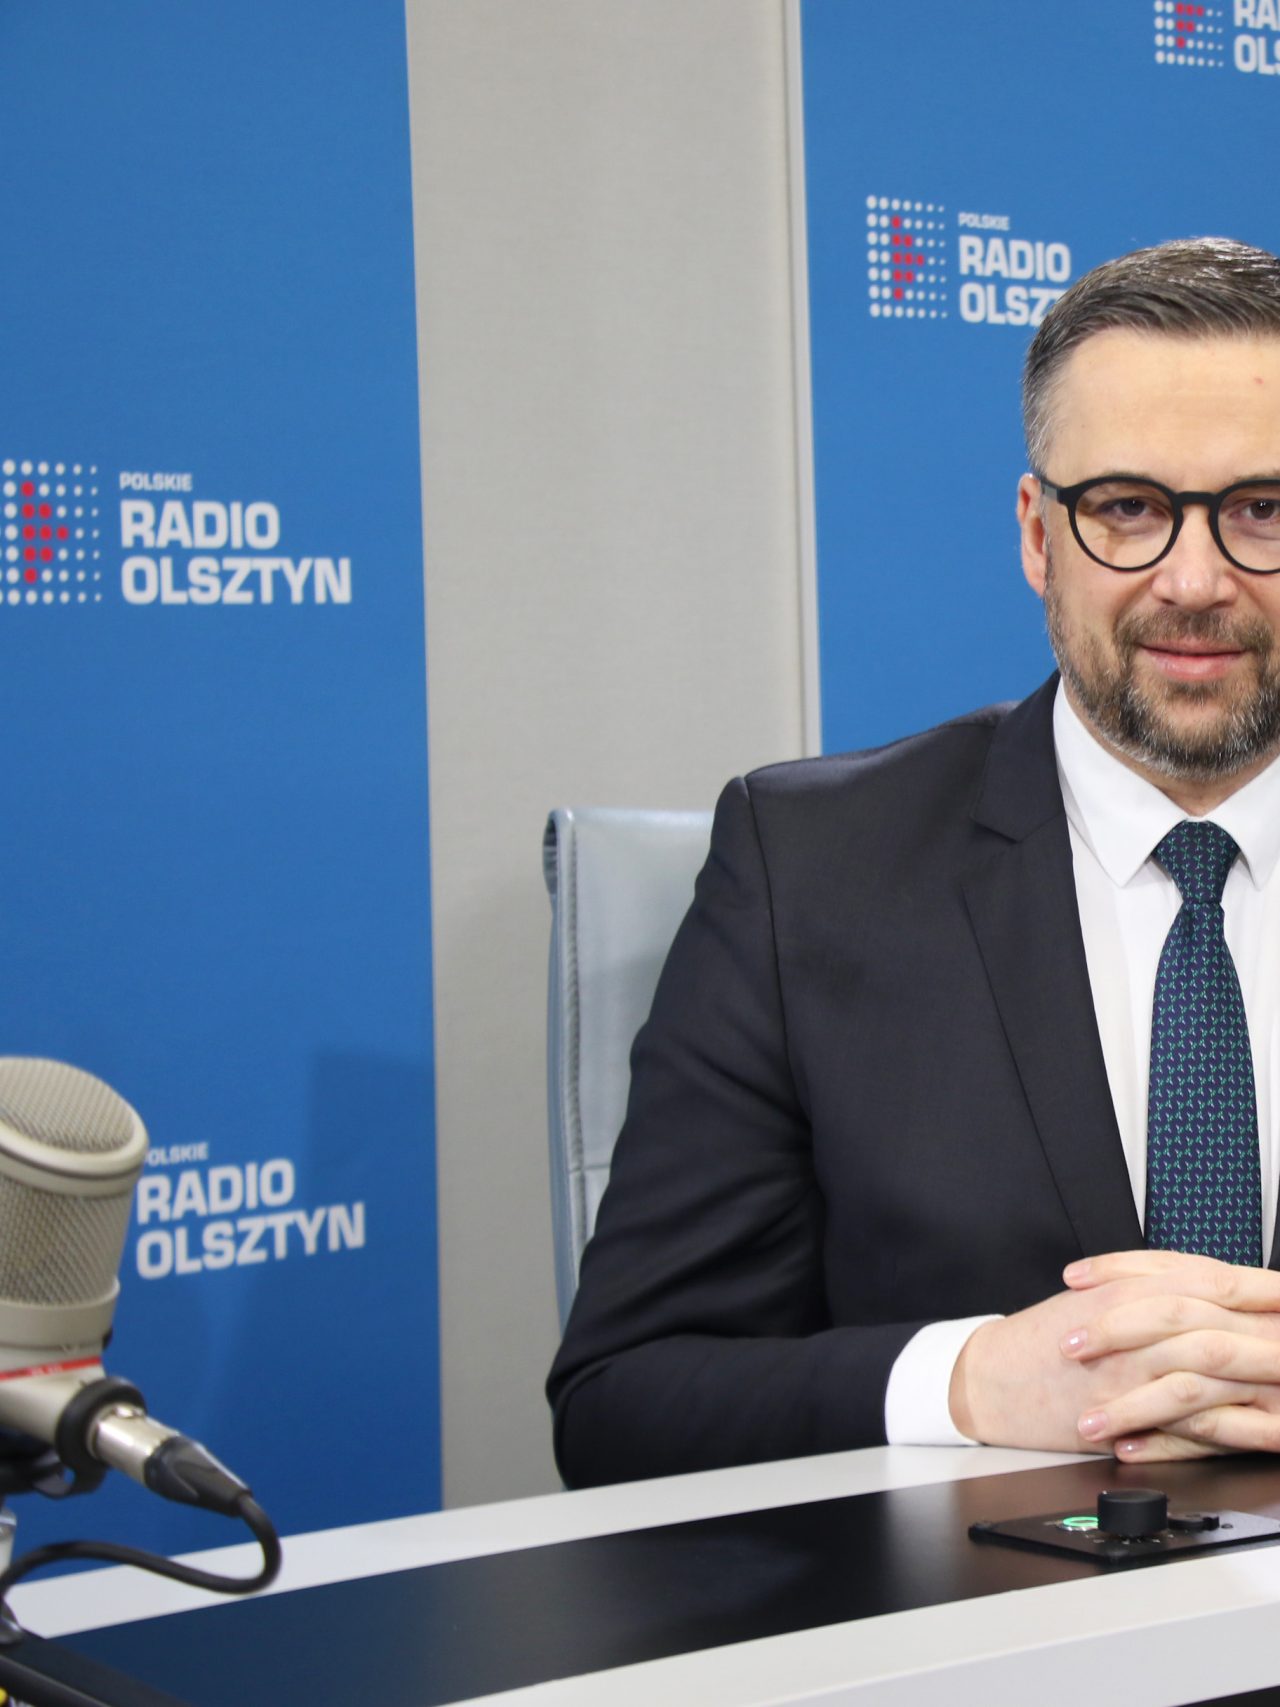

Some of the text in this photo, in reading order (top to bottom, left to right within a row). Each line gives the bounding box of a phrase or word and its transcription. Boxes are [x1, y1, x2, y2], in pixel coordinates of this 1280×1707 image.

[958, 212, 1010, 231] POLSKIE
[958, 235, 1071, 283] RADIO
[959, 281, 1069, 327] OLSZ
[119, 472, 192, 492] POLSKIE
[120, 500, 281, 549] RADIO
[121, 556, 352, 605] OLSZTYN
[136, 1158, 296, 1225] RADIO
[136, 1202, 366, 1280] OLSZTYN
